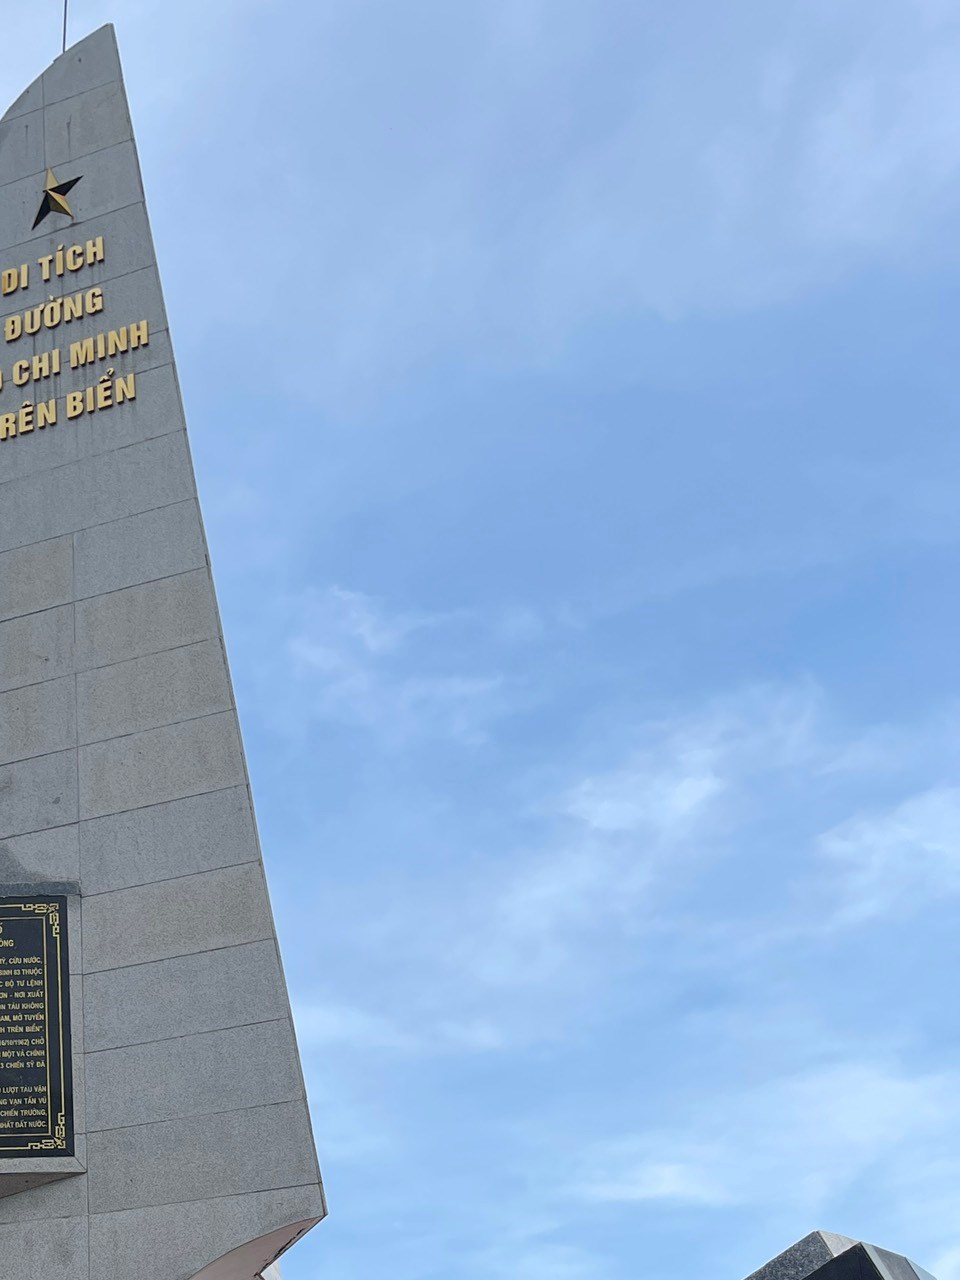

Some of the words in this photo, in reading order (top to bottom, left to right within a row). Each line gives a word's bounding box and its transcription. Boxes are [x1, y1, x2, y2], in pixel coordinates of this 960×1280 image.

[2, 264, 29, 295] DI
[37, 236, 105, 281] TÍCH
[4, 287, 104, 343] ĐƯỜNG
[69, 319, 149, 369] MINH
[65, 367, 136, 420] BIỂN
